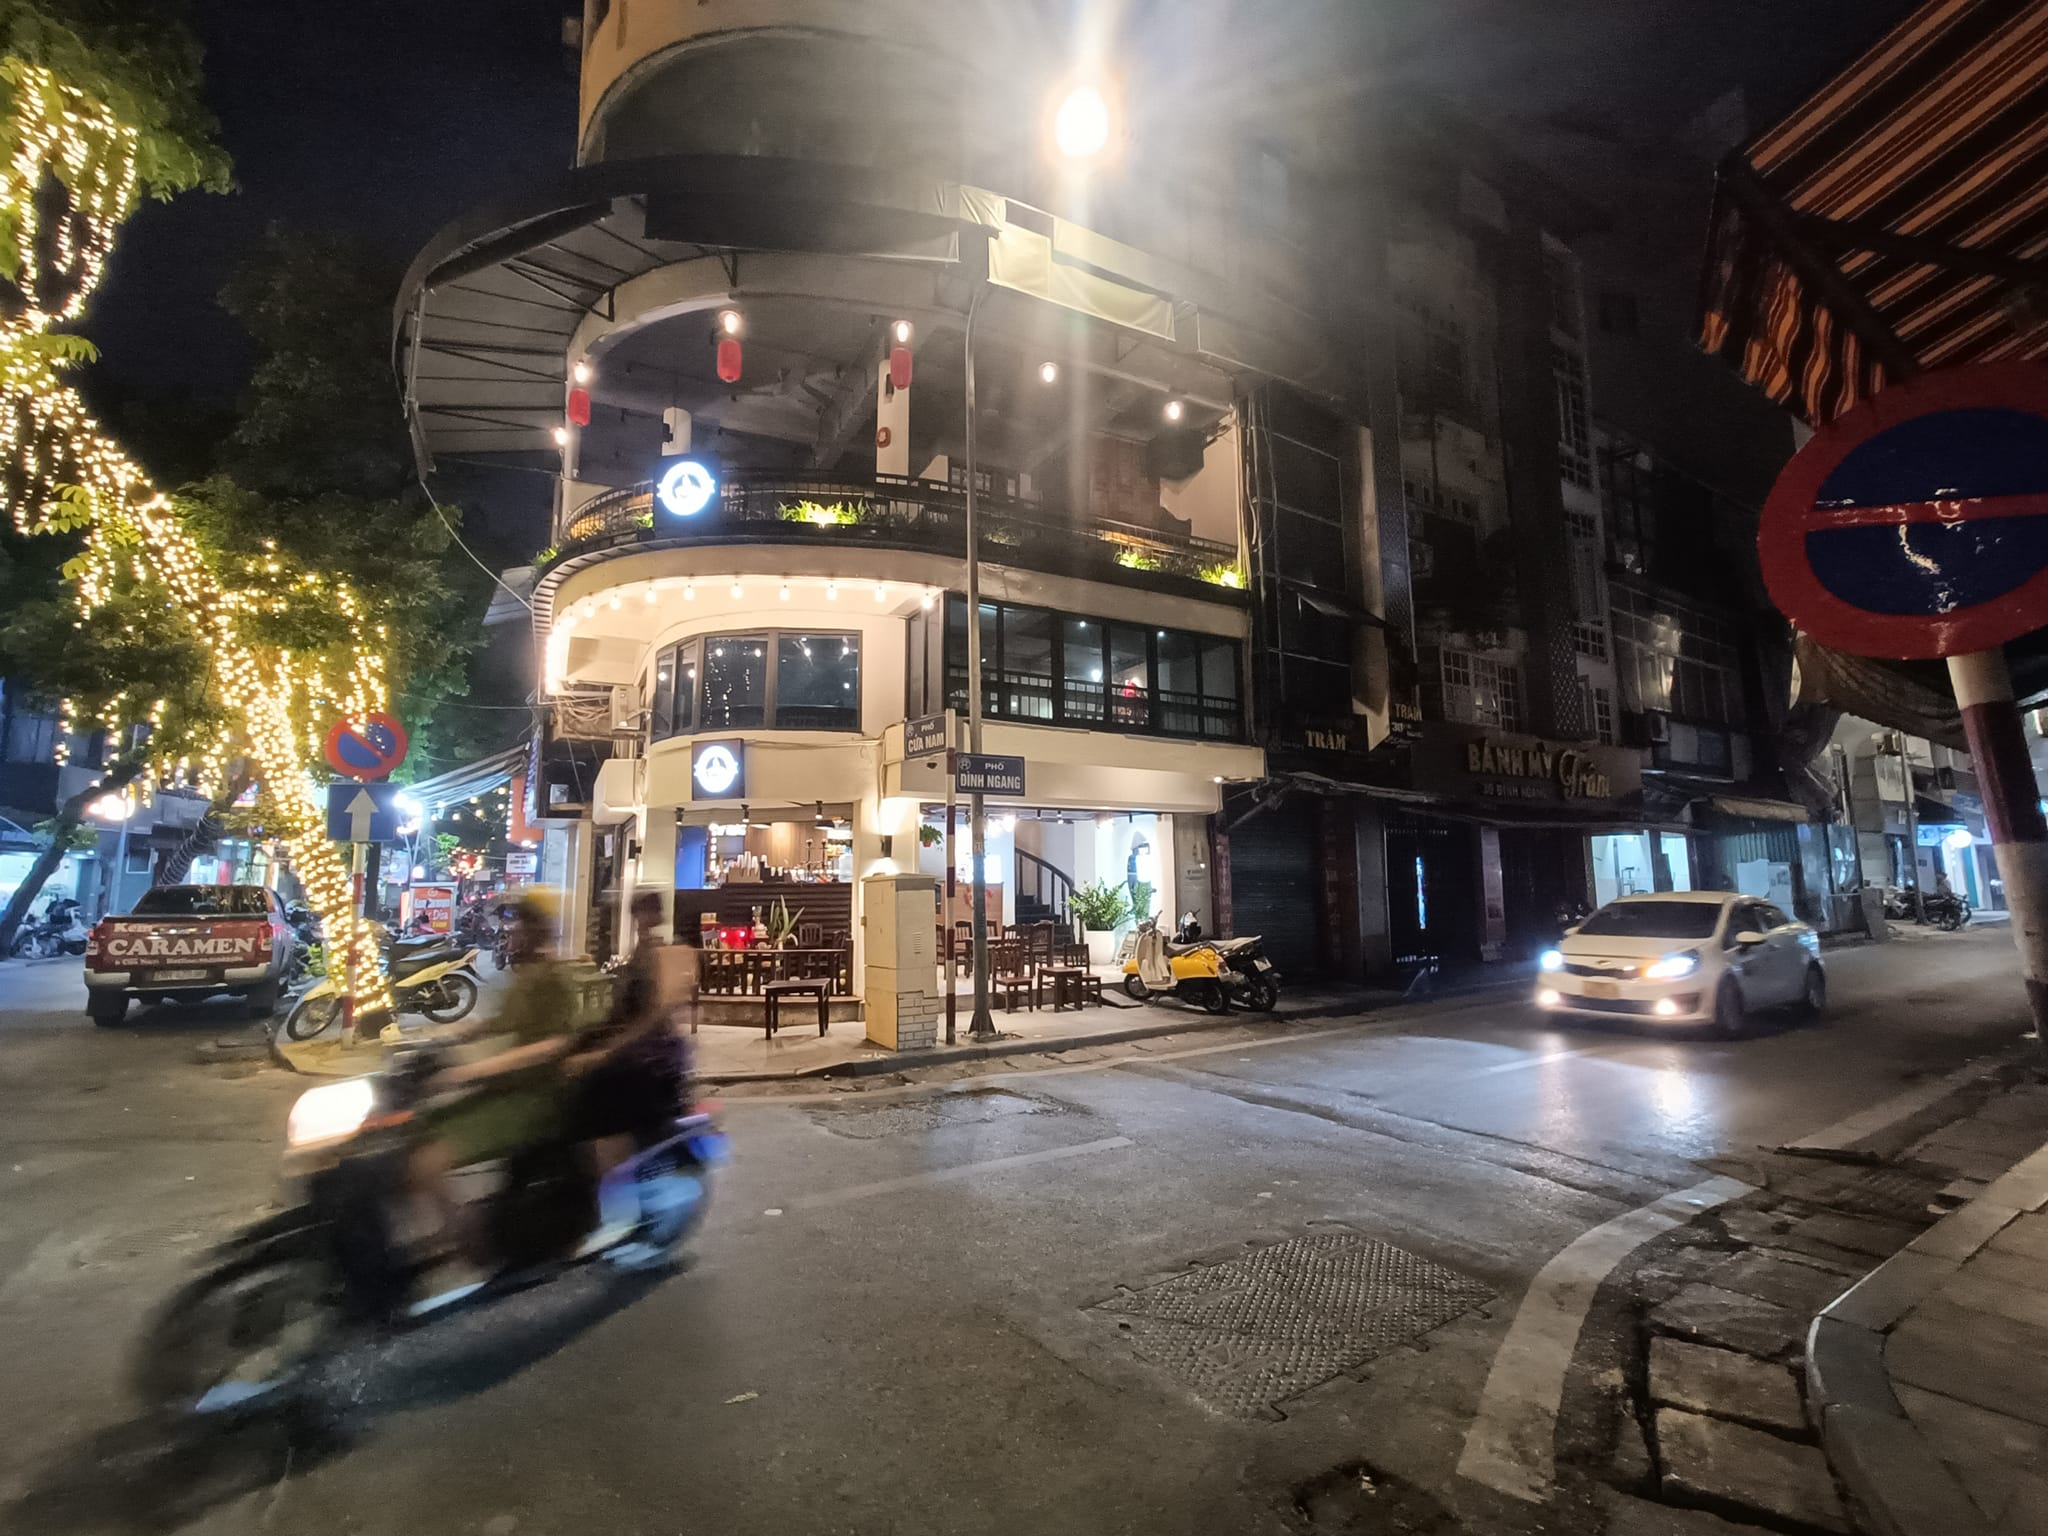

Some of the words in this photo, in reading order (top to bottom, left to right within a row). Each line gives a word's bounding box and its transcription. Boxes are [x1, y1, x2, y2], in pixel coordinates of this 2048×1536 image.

[925, 733, 945, 748] NAM
[984, 761, 1005, 771] PHỐ
[1468, 738, 1524, 777] BÁNH
[960, 770, 985, 788] ĐÌNH
[987, 775, 1021, 790] NGANG
[107, 937, 256, 957] CARAMEN
